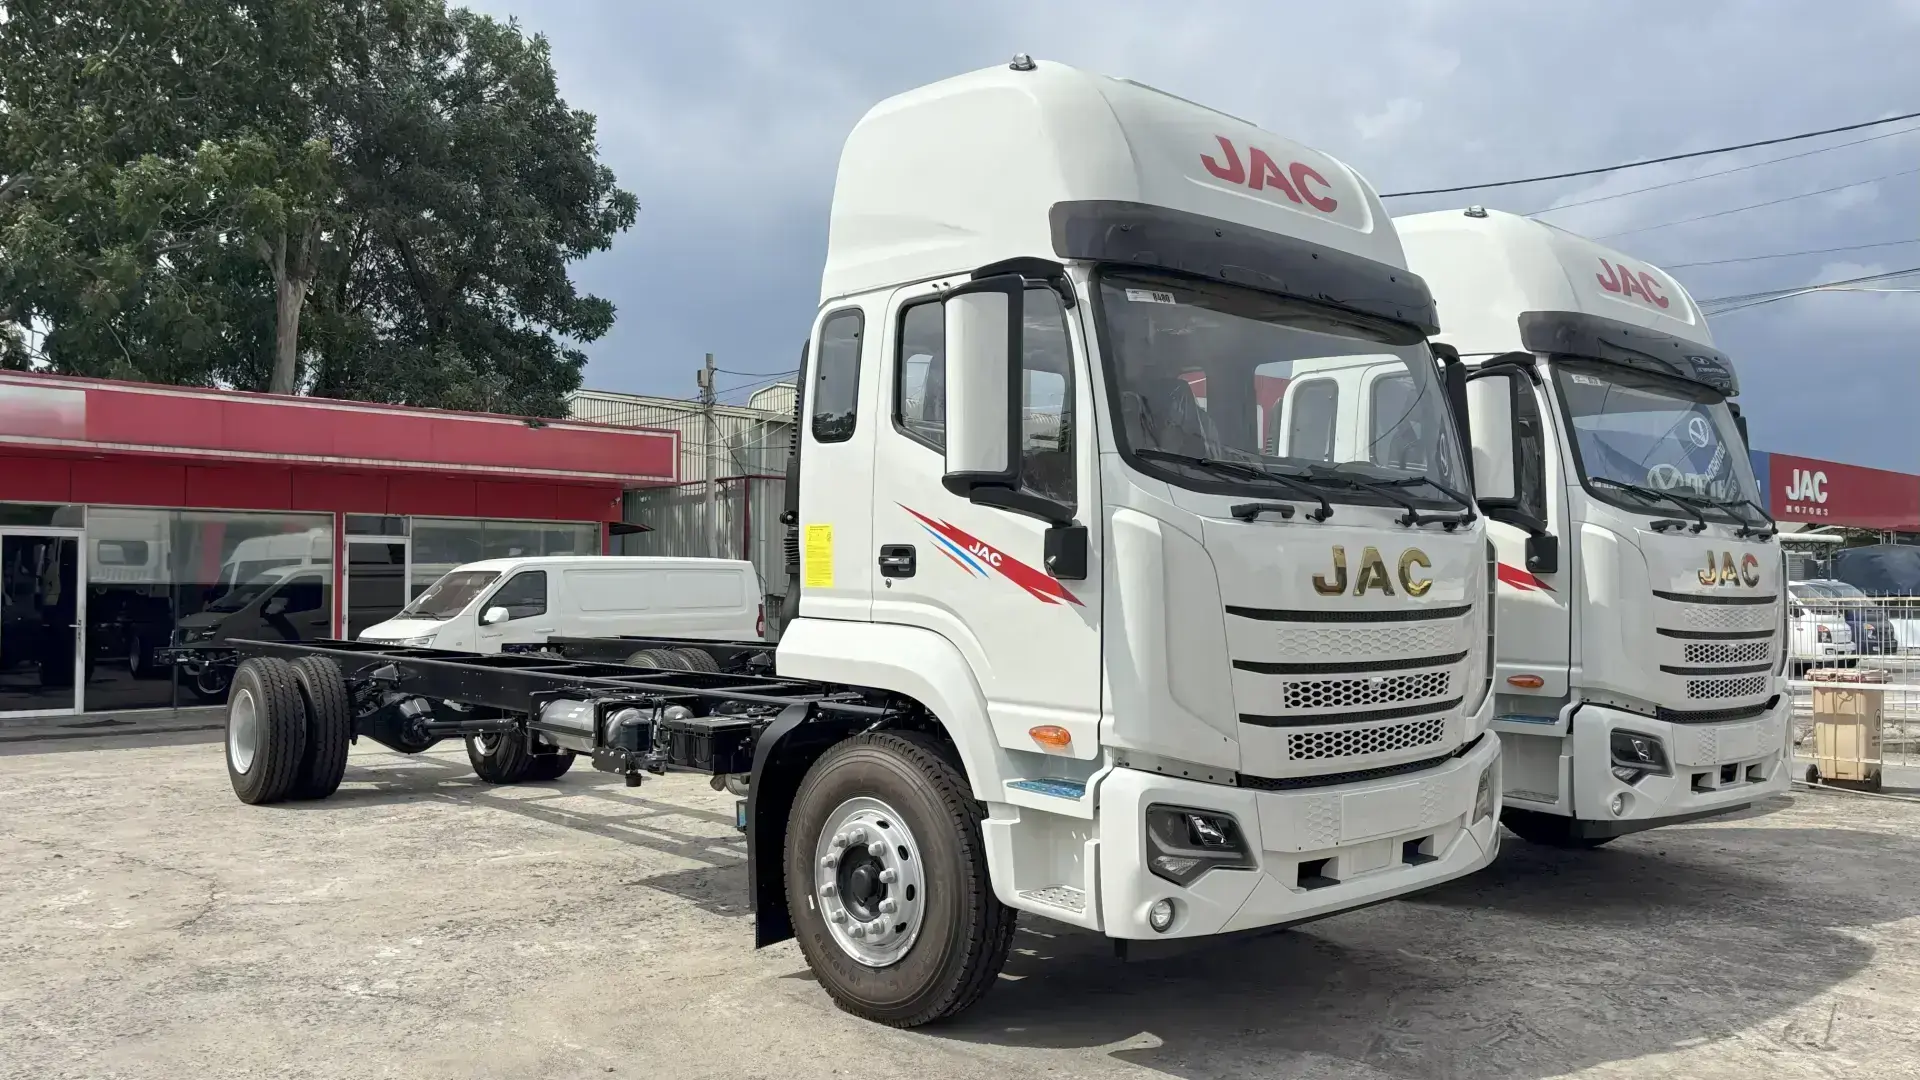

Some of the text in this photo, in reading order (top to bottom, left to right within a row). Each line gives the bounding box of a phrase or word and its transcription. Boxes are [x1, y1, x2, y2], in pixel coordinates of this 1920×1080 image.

[1200, 135, 1338, 213] JAC
[1595, 257, 1669, 309] JAC
[1785, 468, 1828, 504] JAC
[968, 541, 1002, 567] JAC
[1312, 544, 1433, 598] JAC
[1698, 550, 1760, 588] JAC
